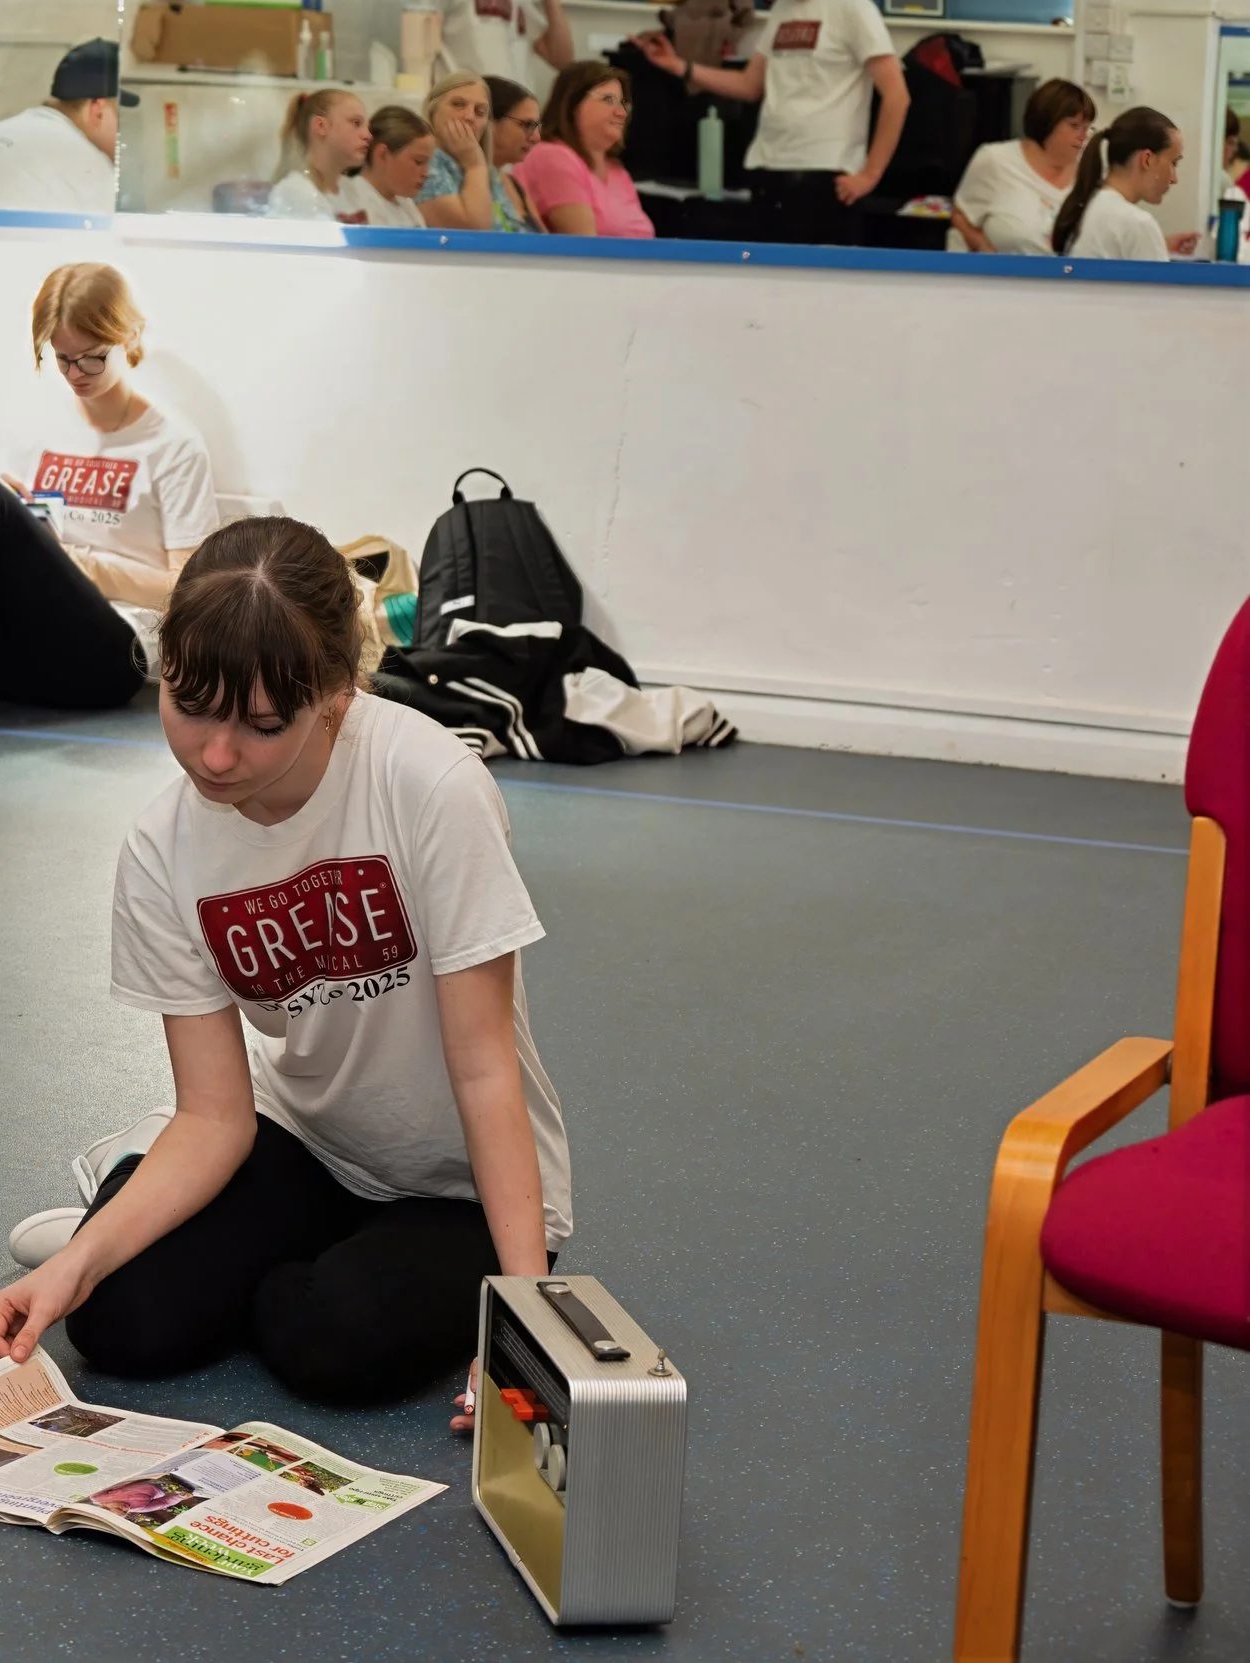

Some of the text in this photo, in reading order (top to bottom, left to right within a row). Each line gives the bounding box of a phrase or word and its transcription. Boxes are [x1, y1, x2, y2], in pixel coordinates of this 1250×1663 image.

[40, 465, 130, 498] GREASE
[91, 511, 120, 525] 2025
[244, 870, 343, 915] WE GO TOGETR
[251, 983, 265, 996] 19
[273, 965, 305, 992] THE
[382, 945, 398, 962] 59
[347, 966, 411, 1002] 2025
[190, 1520, 247, 1548] chance
[205, 1515, 270, 1547] cuttings
[247, 1547, 285, 1564] Last
[271, 1546, 295, 1559] for
